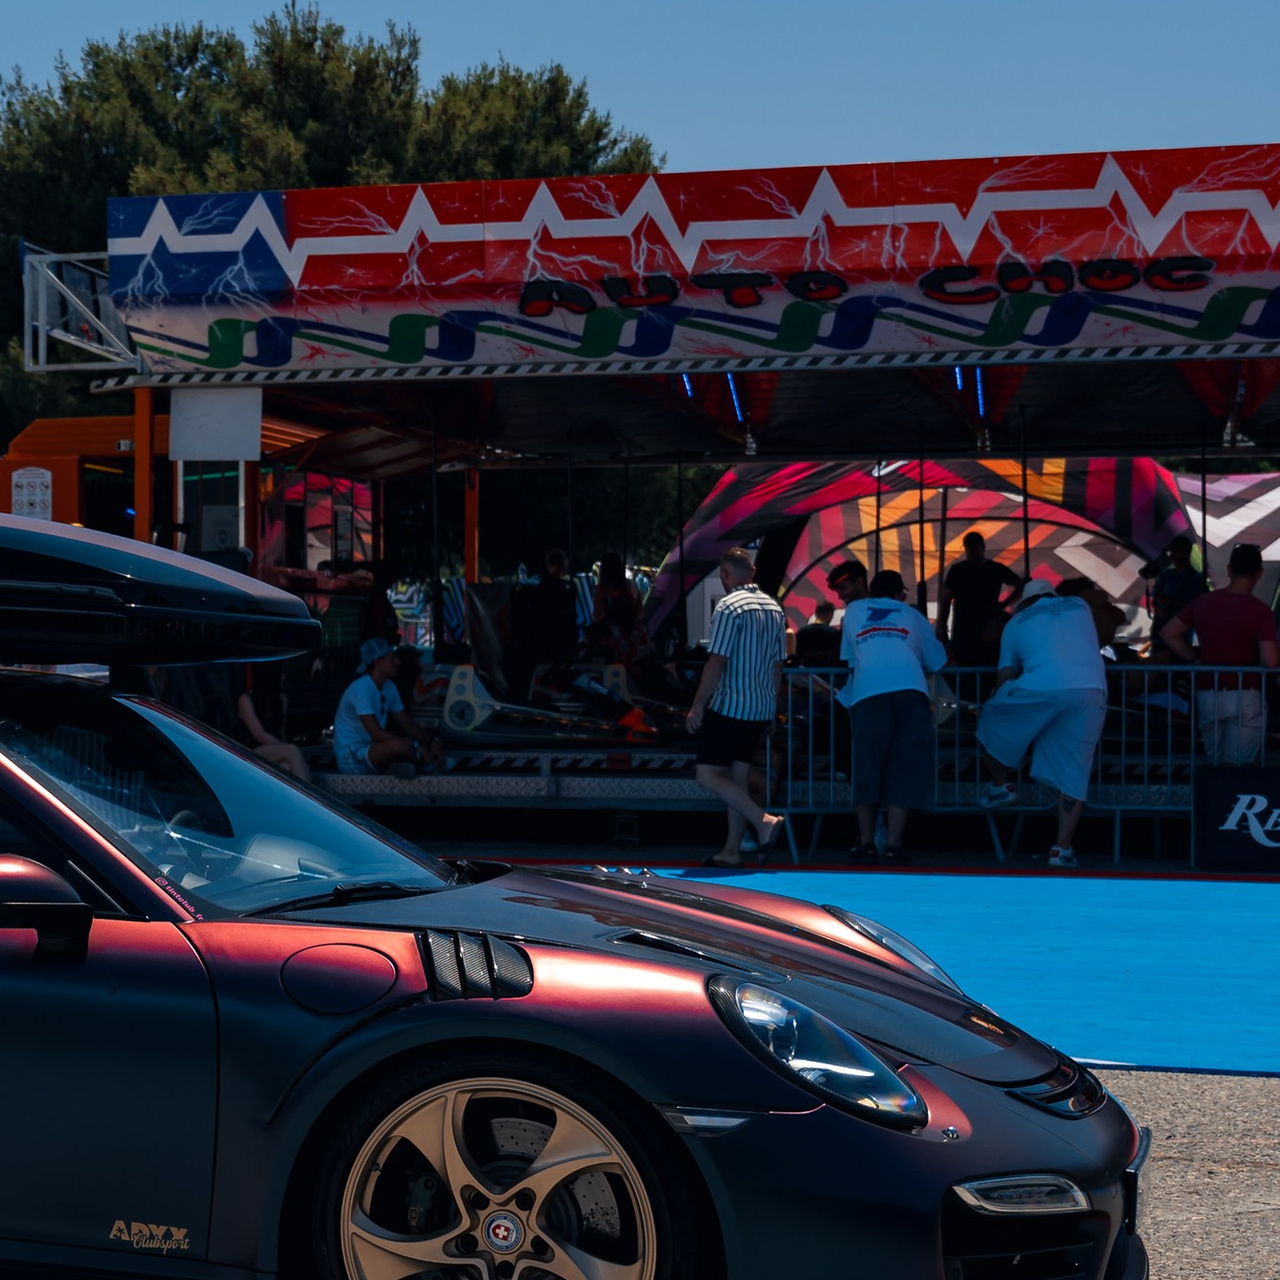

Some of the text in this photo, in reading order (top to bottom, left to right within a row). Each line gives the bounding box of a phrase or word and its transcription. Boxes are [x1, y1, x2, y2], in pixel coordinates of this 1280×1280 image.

[518, 255, 1216, 317] AUTO CHOC
[132, 1231, 190, 1256] Clubsport
